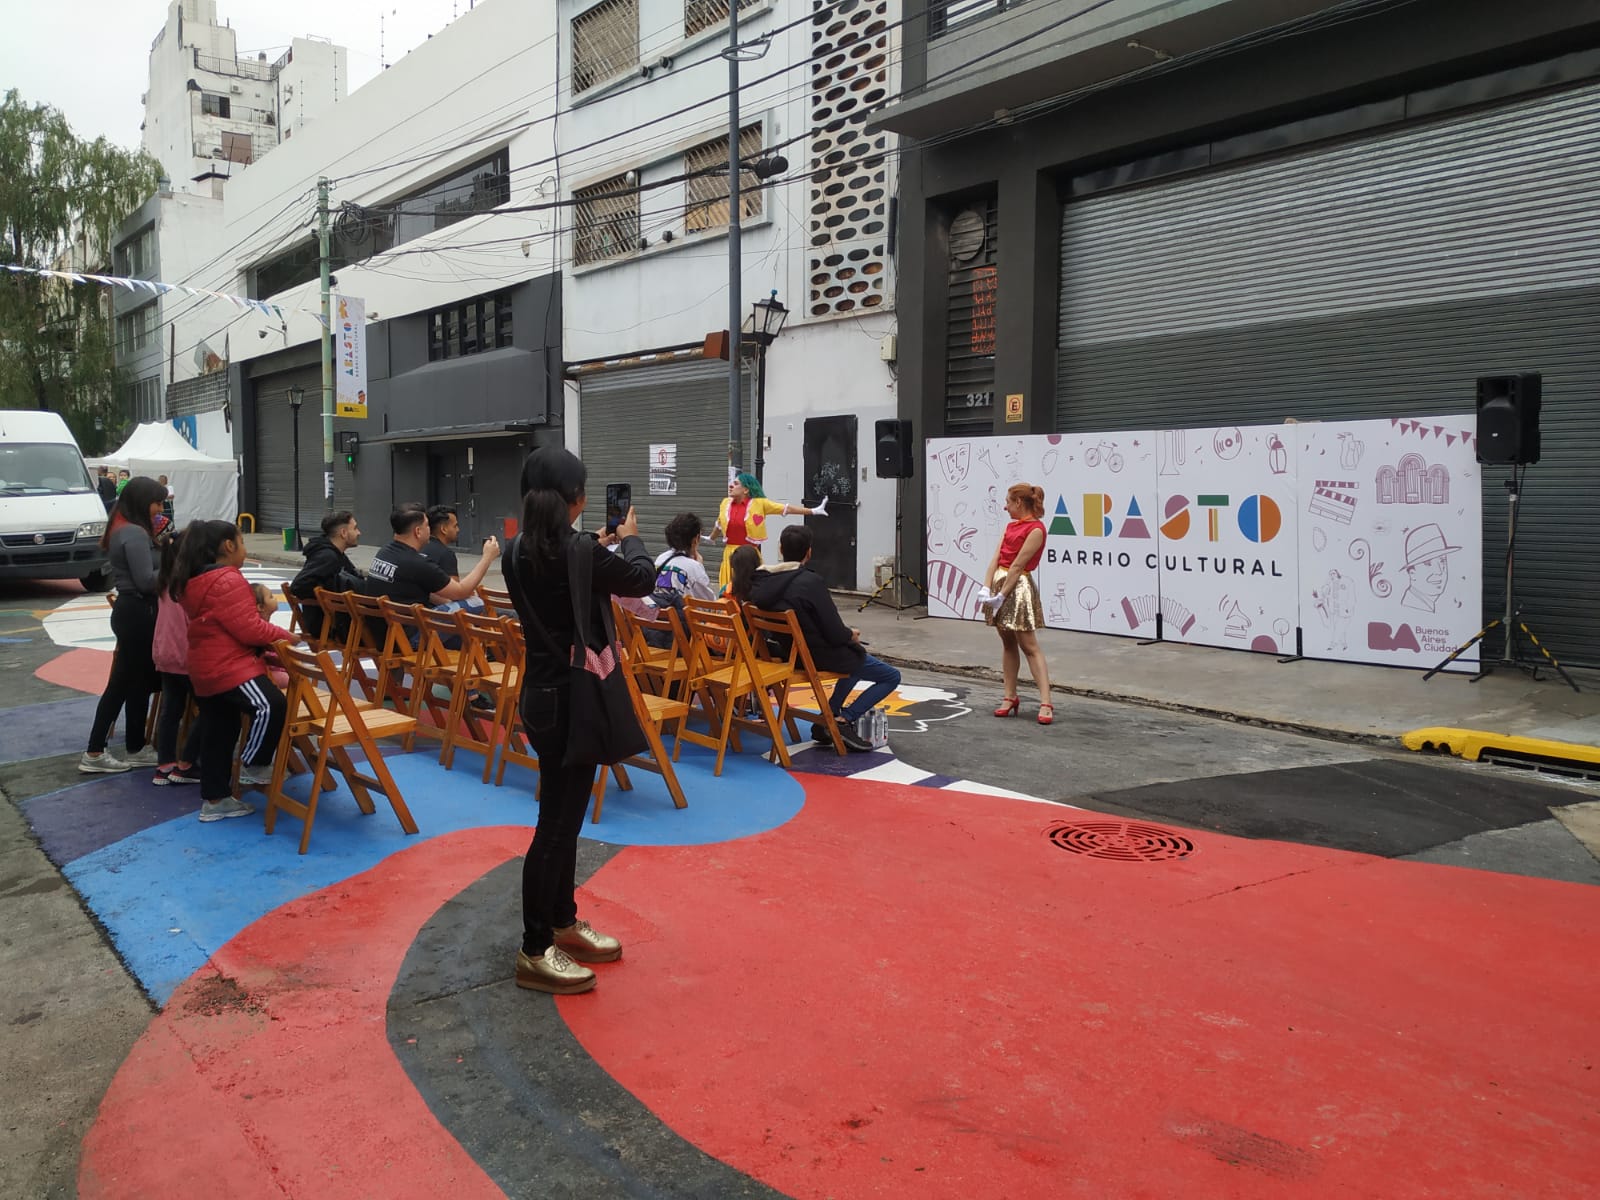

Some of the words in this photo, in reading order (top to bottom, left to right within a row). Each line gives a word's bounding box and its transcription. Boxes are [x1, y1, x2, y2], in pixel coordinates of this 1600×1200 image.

[344, 323, 353, 376] ABASTO
[966, 392, 990, 407] 321
[1047, 493, 1282, 544] ABASTO
[1047, 549, 1131, 568] BARRIO
[1145, 553, 1283, 577] CULTURAL
[1368, 621, 1421, 653] BA
[1415, 625, 1449, 636] Buenos
[1421, 635, 1447, 644] Aires
[1423, 643, 1458, 653] Ciudad
